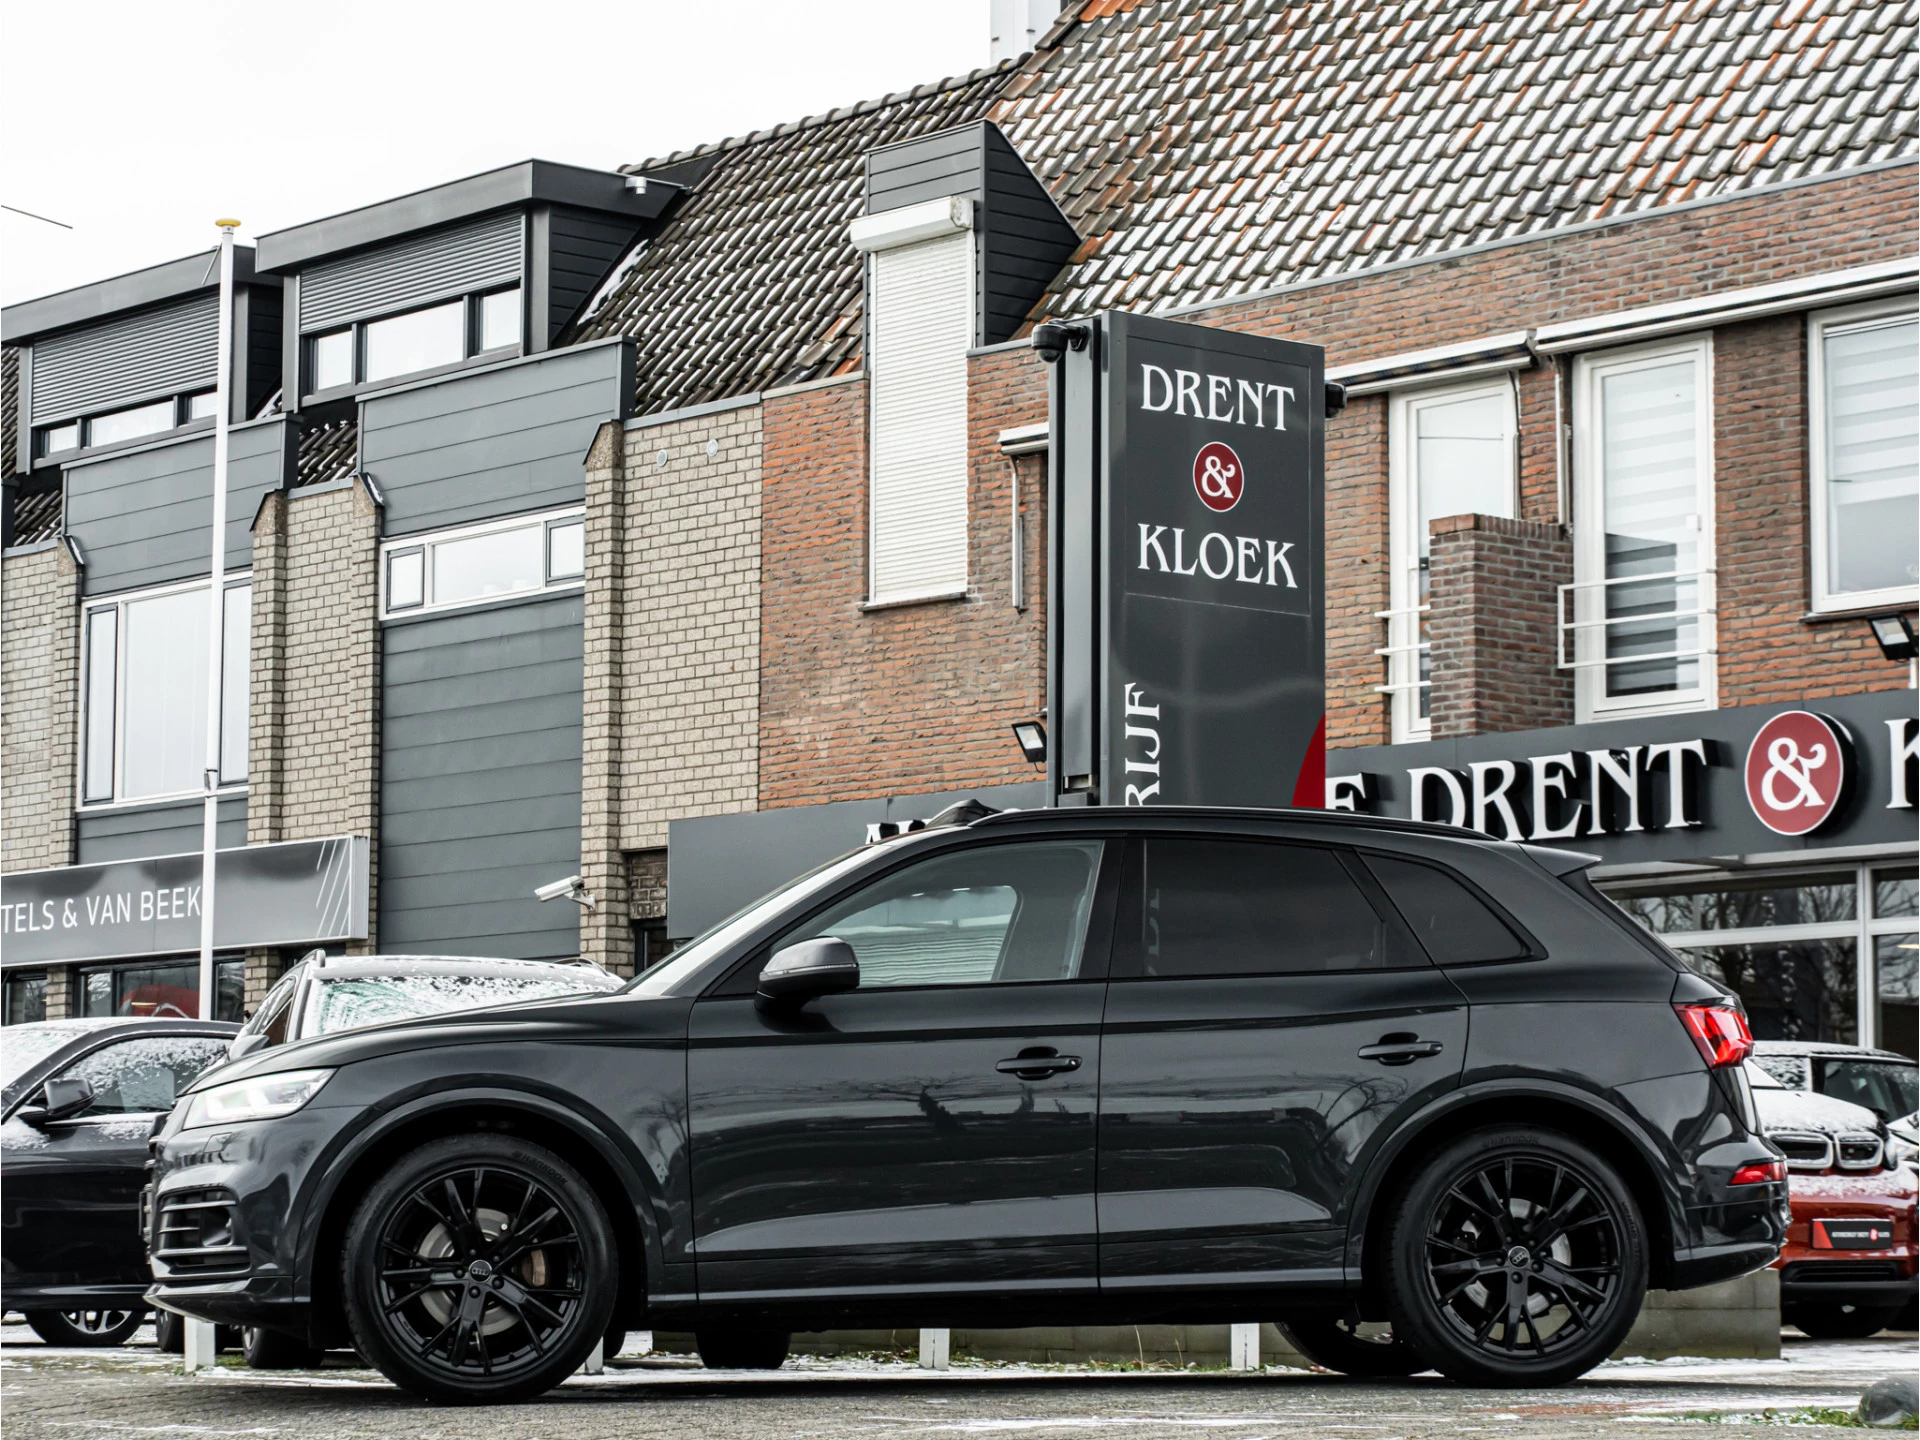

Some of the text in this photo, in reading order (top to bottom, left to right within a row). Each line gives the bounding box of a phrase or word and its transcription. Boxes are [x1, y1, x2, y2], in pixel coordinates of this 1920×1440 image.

[1141, 363, 1296, 431] DRENT
[1201, 455, 1235, 499] &
[1137, 522, 1298, 589] KLOEK
[1406, 738, 1707, 842] DRENT
[1760, 737, 1827, 812] &
[1, 886, 201, 933] TELS & VAN BEEK
